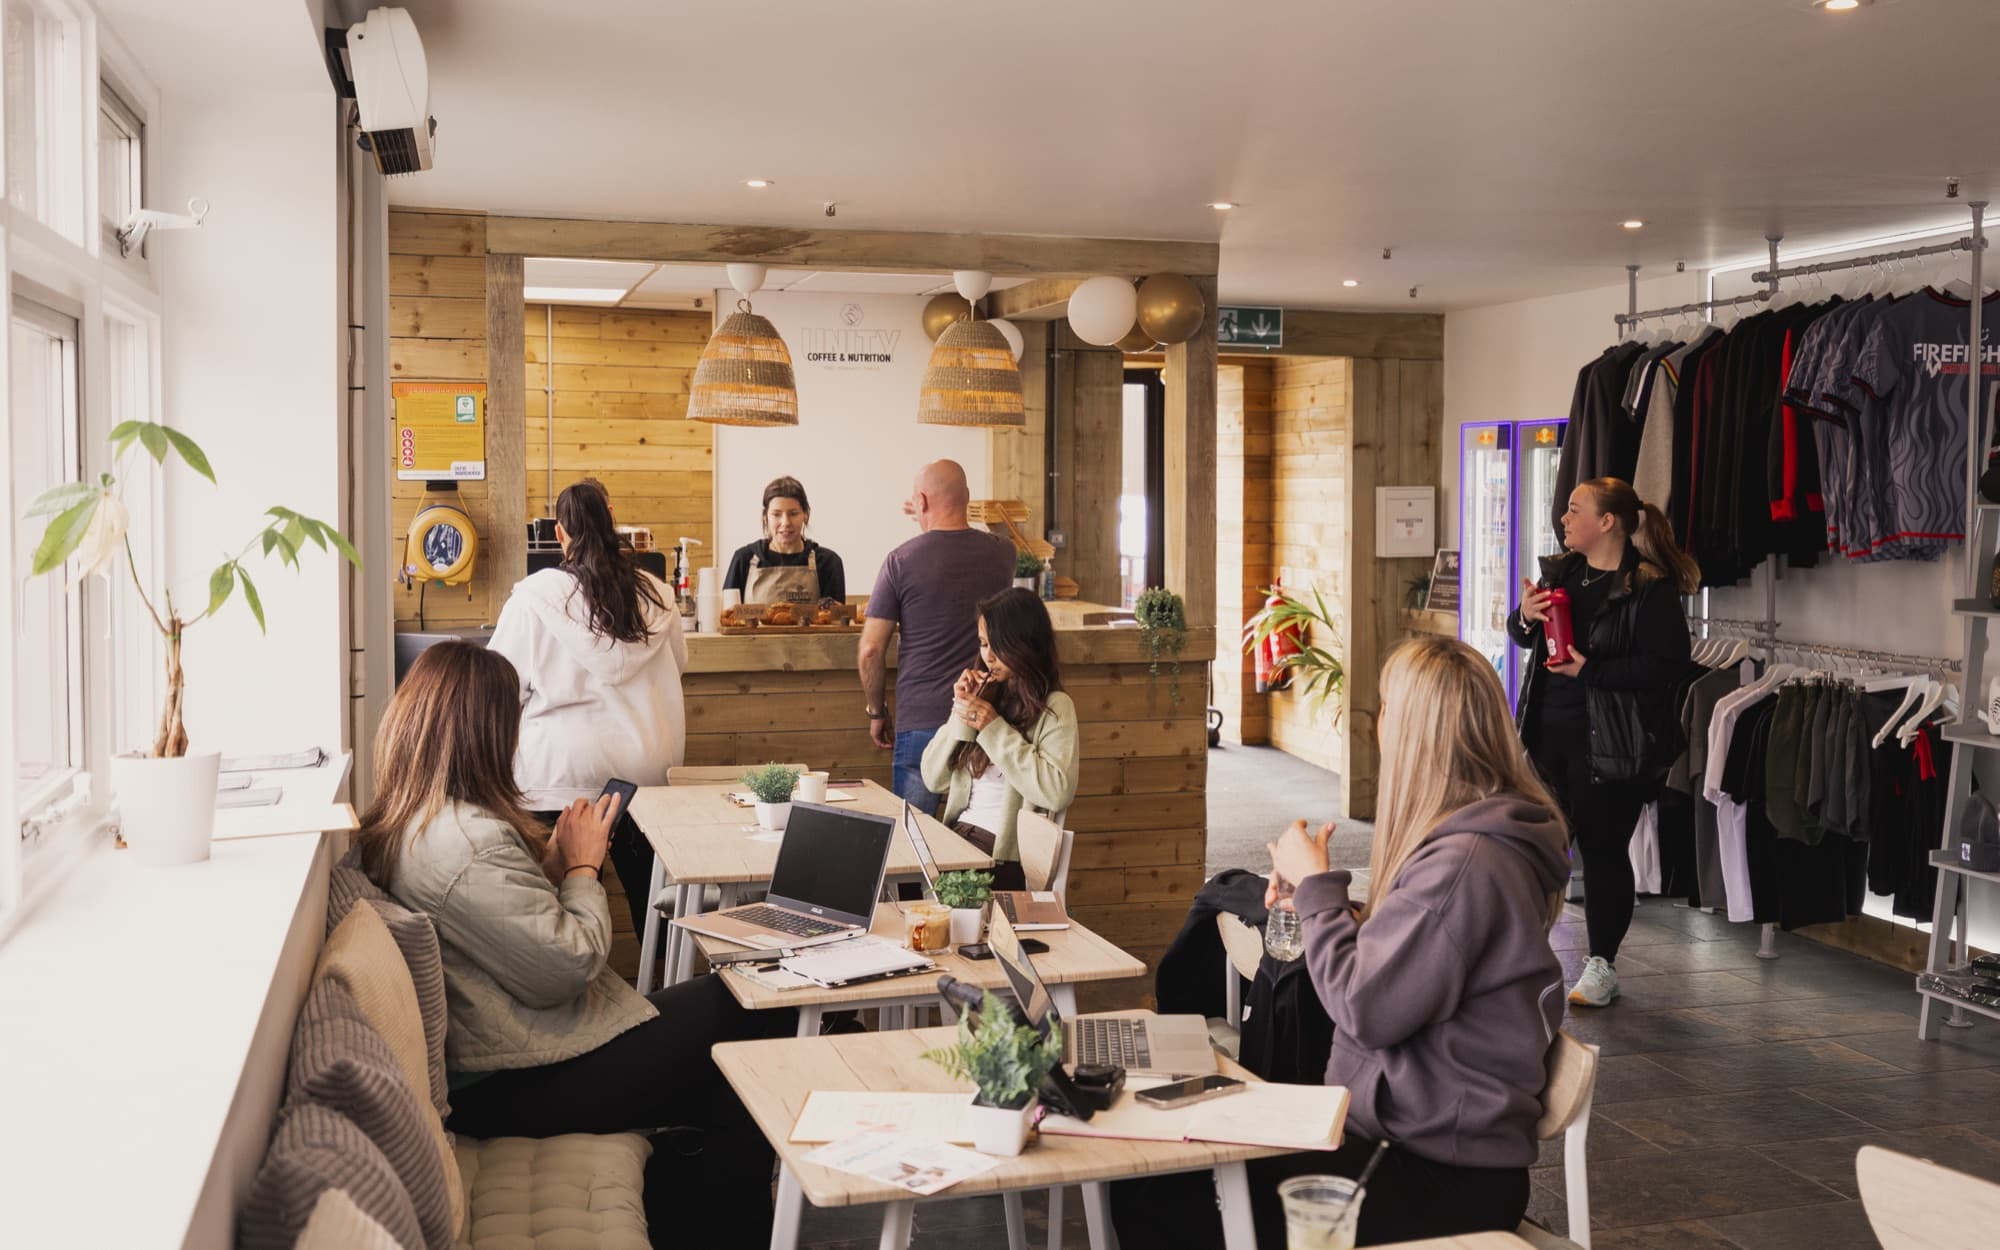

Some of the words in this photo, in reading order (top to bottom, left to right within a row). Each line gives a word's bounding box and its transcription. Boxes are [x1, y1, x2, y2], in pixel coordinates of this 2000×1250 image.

[801, 328, 902, 363] UNITY
[807, 352, 837, 362] COFFEE
[839, 353, 845, 362] &
[848, 353, 891, 362] NUTRITION
